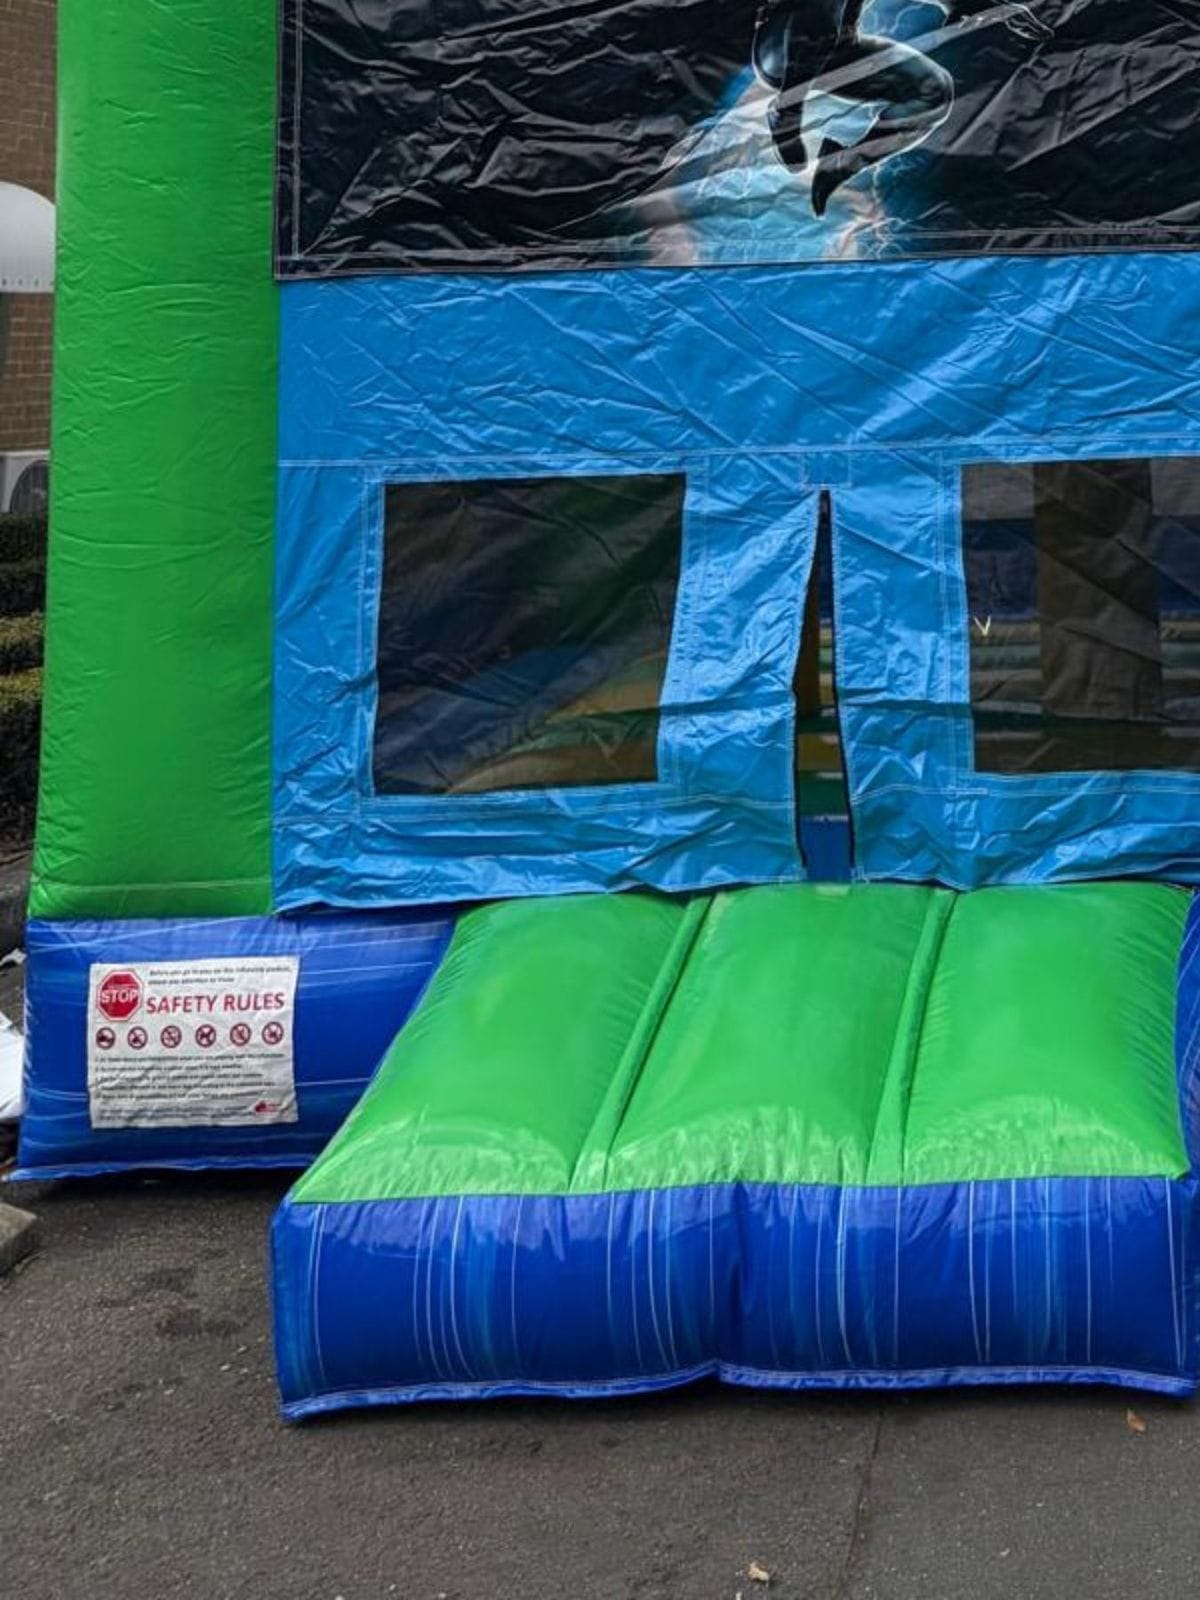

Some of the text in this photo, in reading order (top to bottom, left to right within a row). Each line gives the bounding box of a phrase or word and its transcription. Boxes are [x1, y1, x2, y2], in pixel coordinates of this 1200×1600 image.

[101, 989, 139, 1004] STOP
[146, 992, 285, 1014] SAFETY RULES
